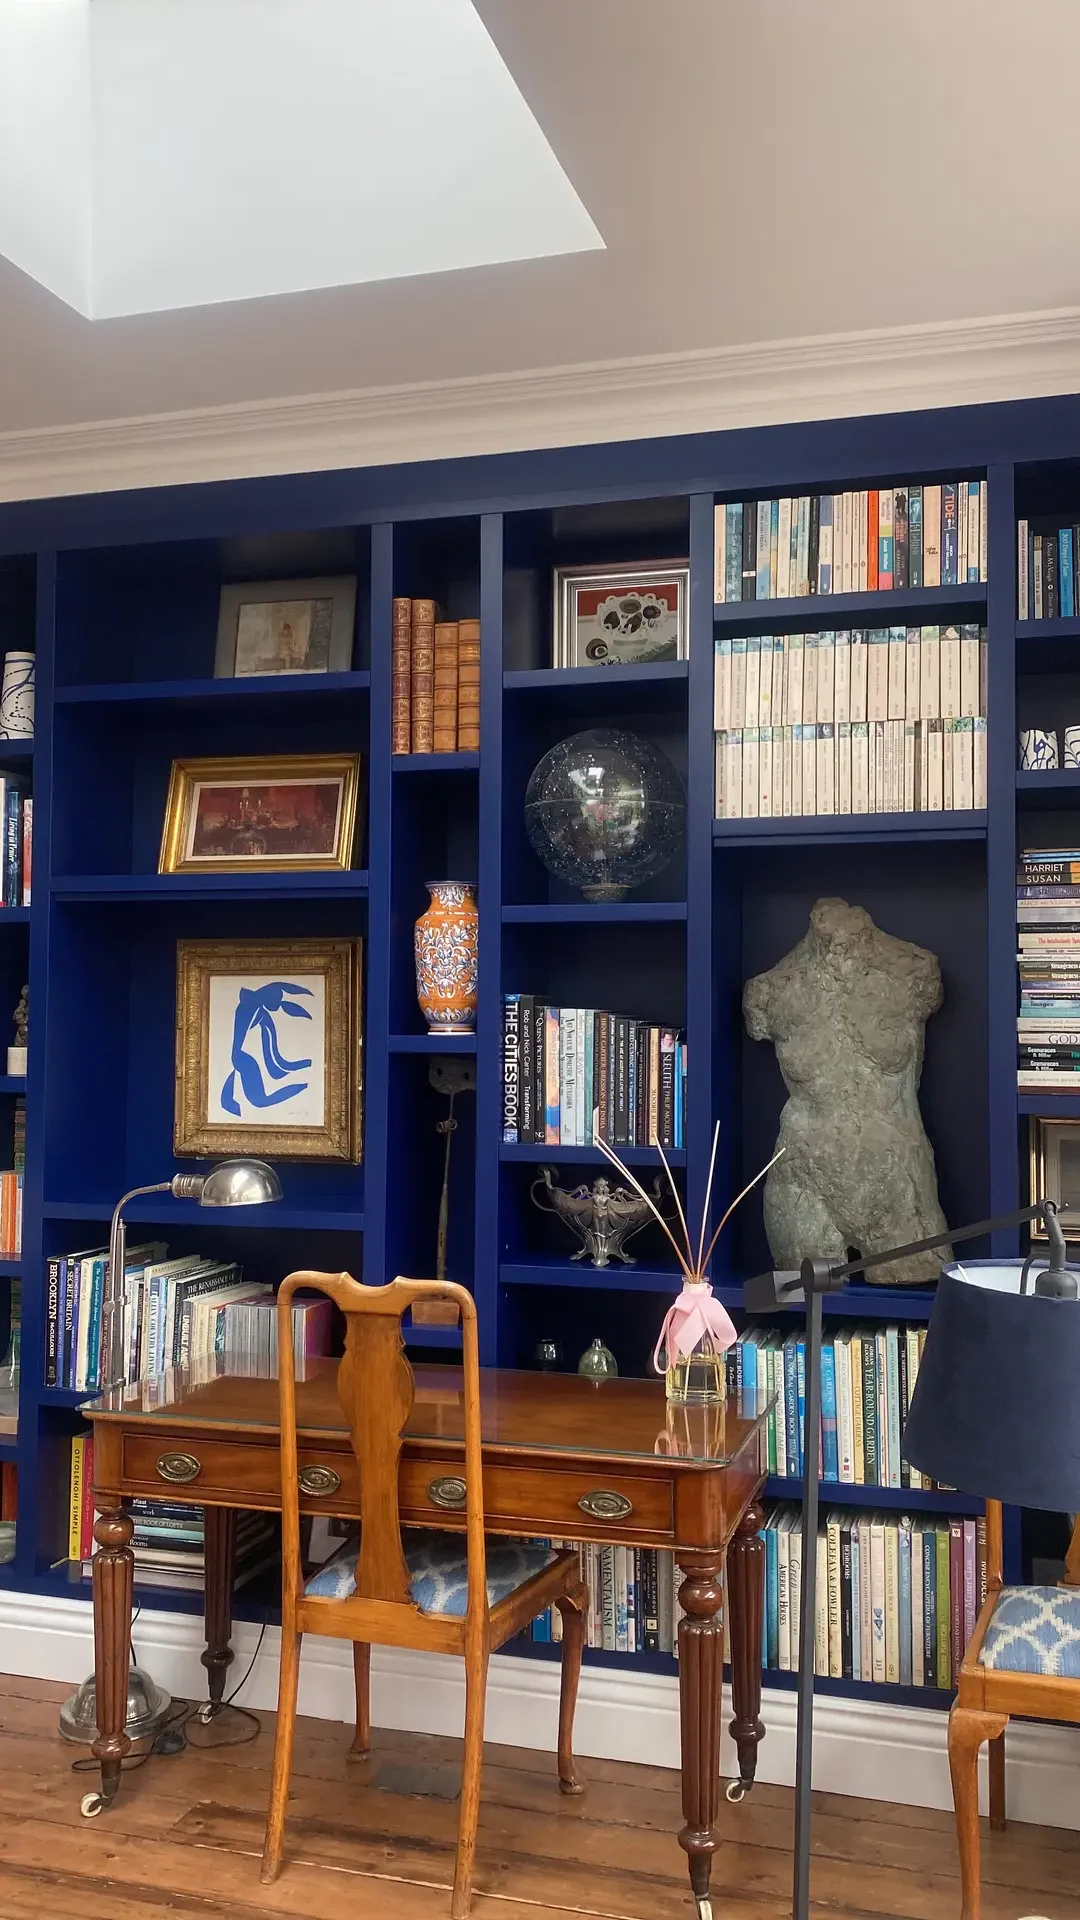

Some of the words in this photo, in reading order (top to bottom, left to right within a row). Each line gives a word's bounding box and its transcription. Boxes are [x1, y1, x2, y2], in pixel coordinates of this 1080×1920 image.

[945, 494, 955, 518] TIDE
[1025, 864, 1064, 872] HARRIET
[1026, 874, 1061, 883] SUSAN
[504, 1002, 518, 1032] THE
[524, 1009, 532, 1024] Rob
[524, 1025, 532, 1038] and
[1048, 1034, 1078, 1044] GOD
[504, 1034, 518, 1083] CITIES
[524, 1039, 532, 1054] Nick
[524, 1056, 532, 1078] Carter
[663, 1054, 671, 1089] SLEUTH
[504, 1084, 518, 1128] BOOK
[524, 1085, 532, 1130] Transforming
[49, 1264, 57, 1319] BROOKLYN
[188, 1284, 198, 1294] THE
[865, 1368, 874, 1425] YEAR-ROUND
[866, 1427, 875, 1464] GARDEN
[780, 1563, 788, 1598] AMERICAN
[790, 1559, 800, 1588] Green
[965, 1560, 974, 1580] Class
[965, 1582, 974, 1607] Master
[780, 1600, 788, 1626] HOUSES
